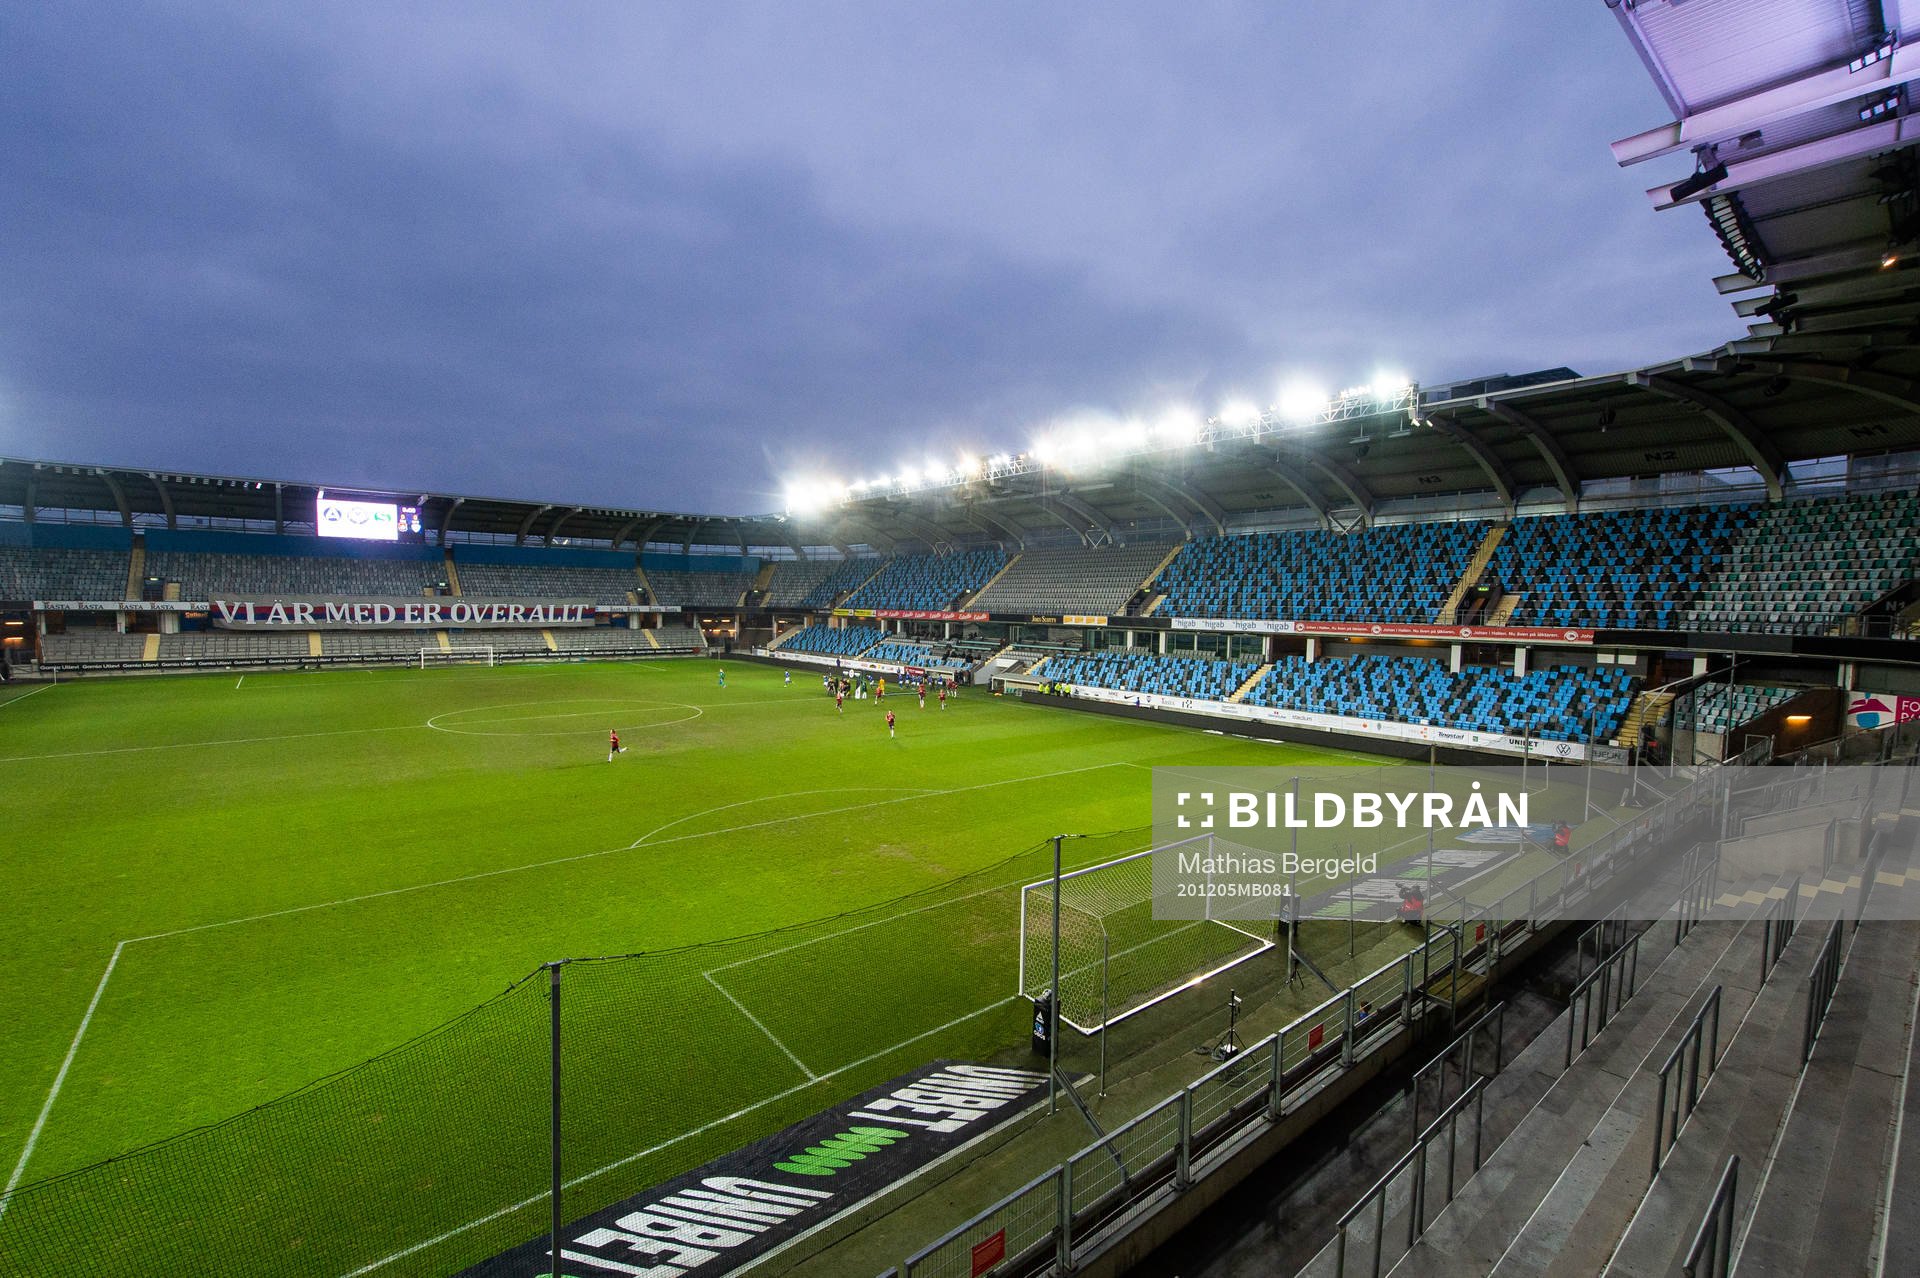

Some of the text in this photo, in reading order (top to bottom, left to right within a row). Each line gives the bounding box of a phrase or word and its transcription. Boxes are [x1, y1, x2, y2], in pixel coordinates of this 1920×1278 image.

[215, 599, 589, 625] VI ÄR MED ER ÖVERALLT
[847, 1065, 1051, 1133] UNIBET
